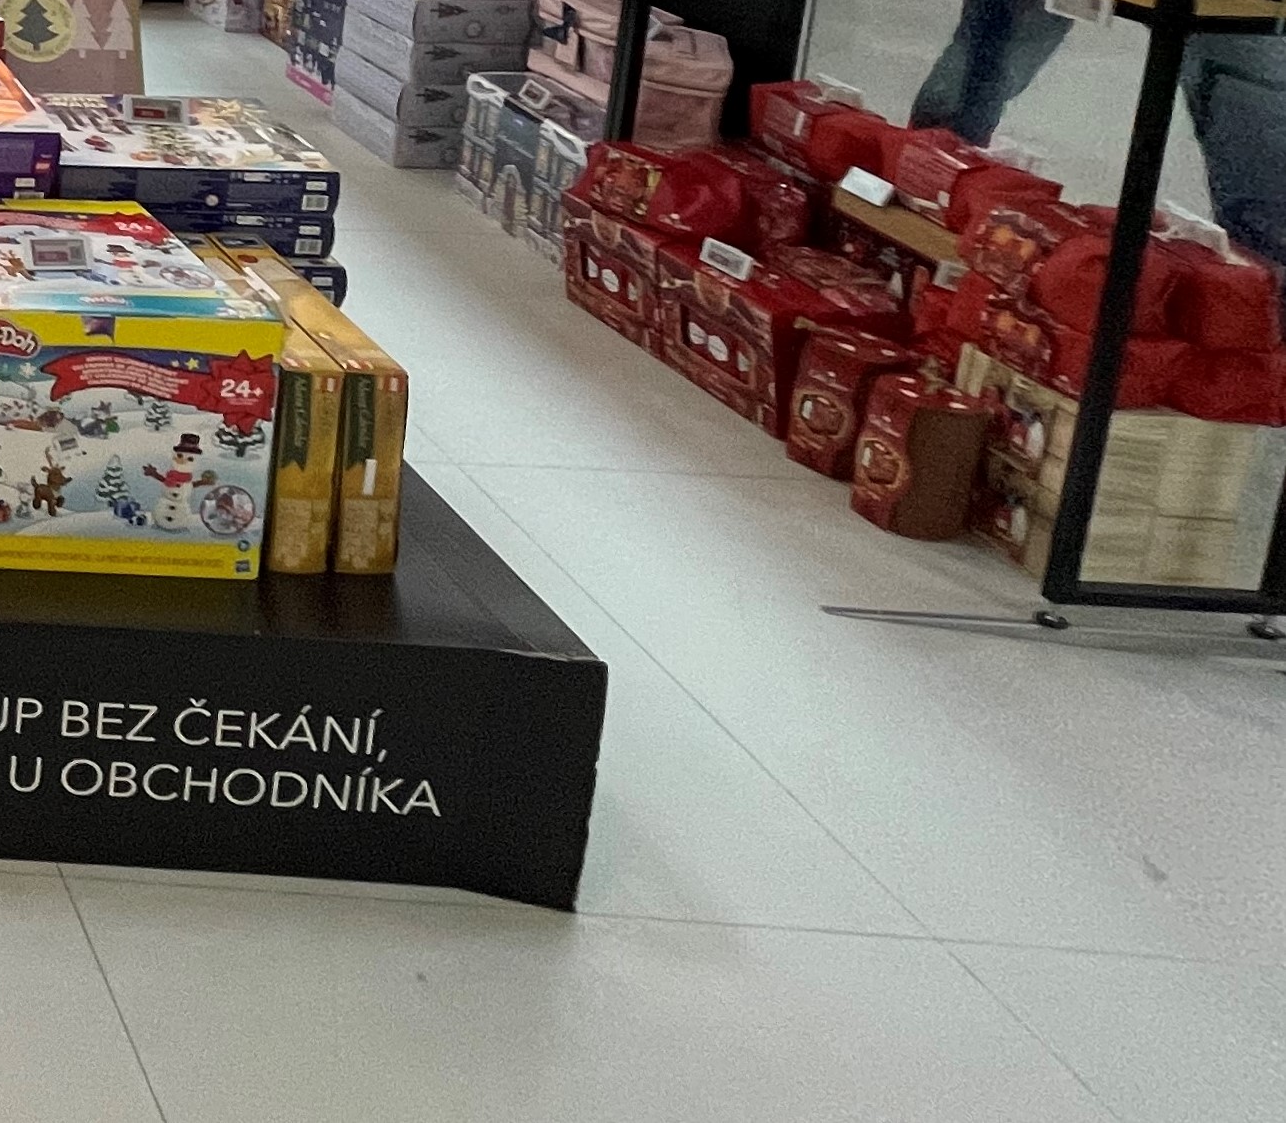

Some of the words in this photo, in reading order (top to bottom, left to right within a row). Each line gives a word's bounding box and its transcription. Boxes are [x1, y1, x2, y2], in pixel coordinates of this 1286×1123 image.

[220, 379, 264, 399] 24+
[61, 700, 159, 742] BEZ
[173, 698, 388, 763] ČEKÁNÍ,
[10, 756, 44, 793] U
[59, 757, 443, 818] OBCHODNÍKA
